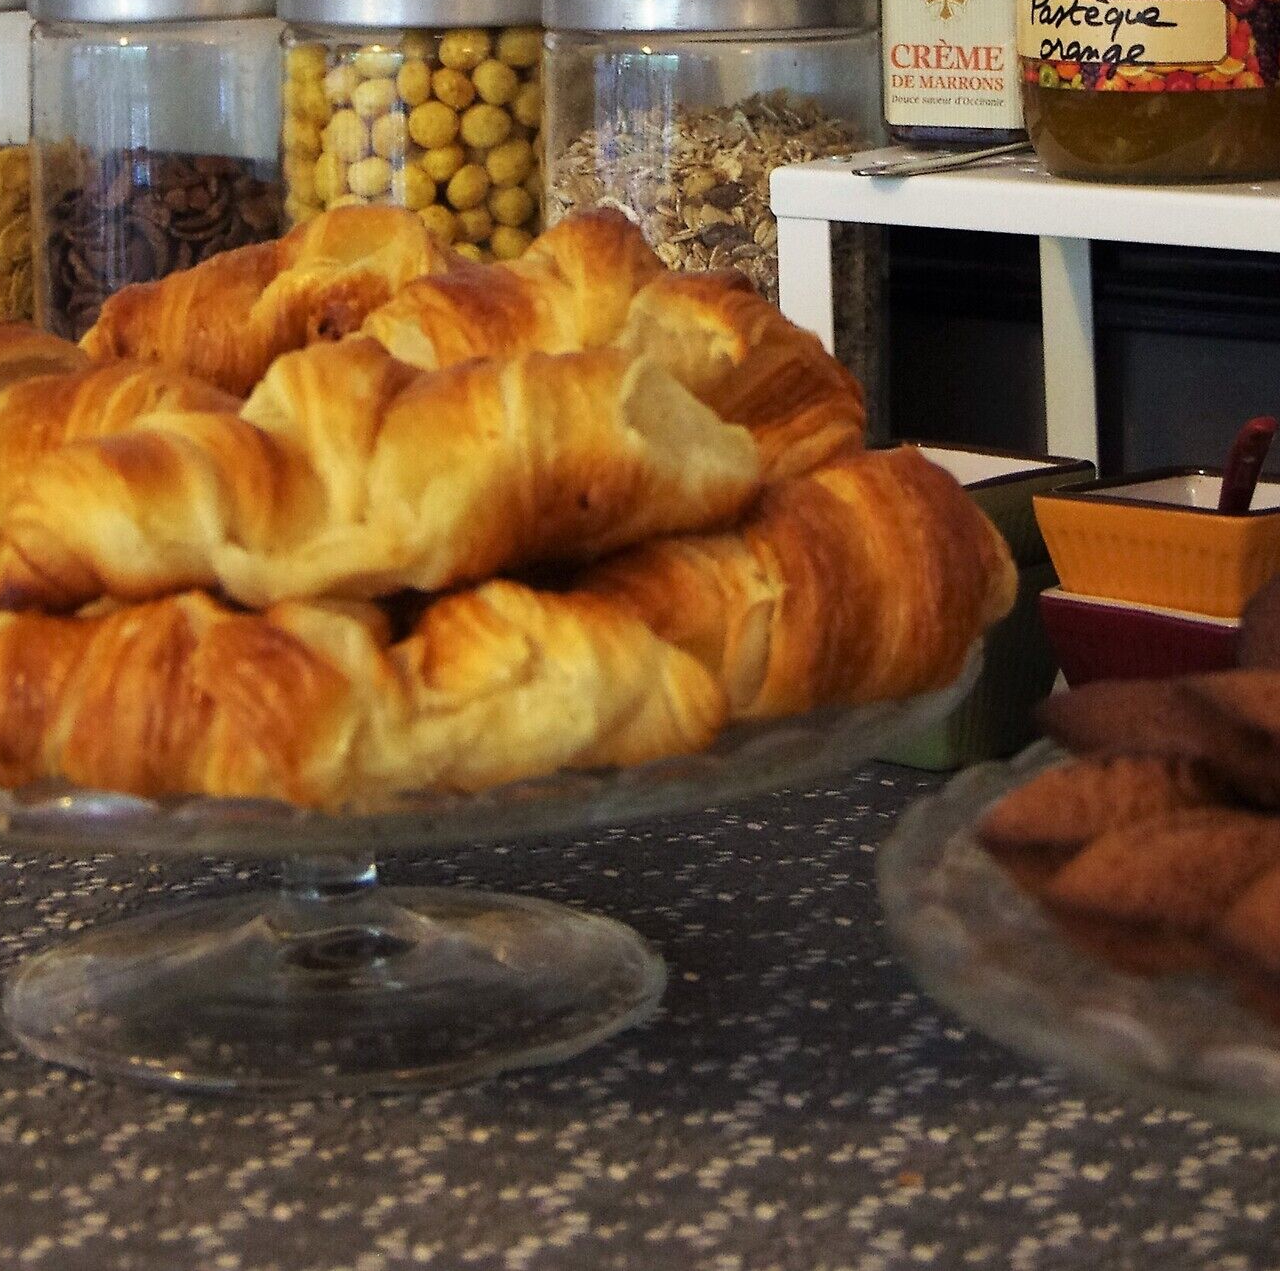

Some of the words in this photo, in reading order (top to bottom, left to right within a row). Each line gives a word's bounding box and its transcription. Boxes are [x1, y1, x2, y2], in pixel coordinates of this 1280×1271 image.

[890, 38, 1004, 71] CRÈME
[1040, 37, 1156, 80] orange
[892, 74, 915, 89] DE
[919, 75, 1004, 91] MARRONS
